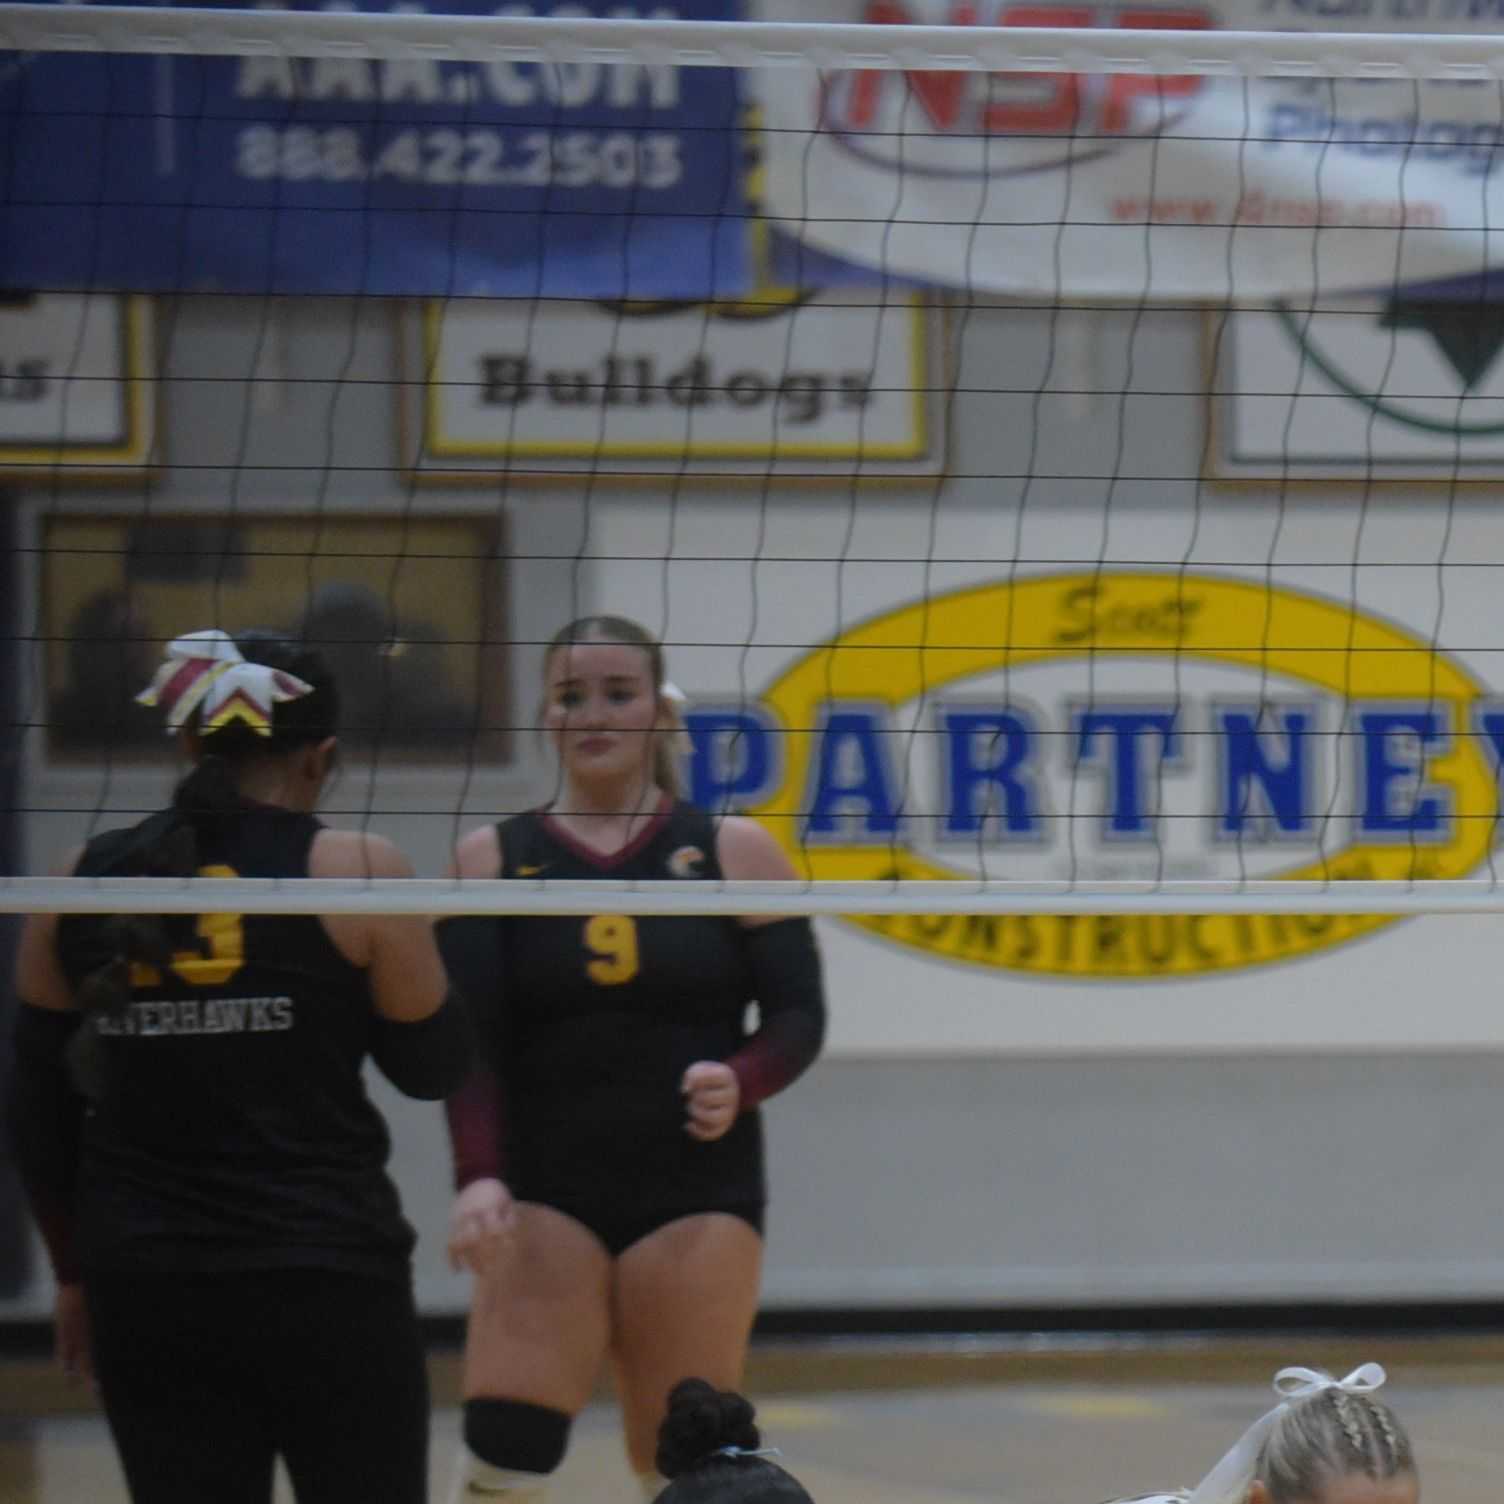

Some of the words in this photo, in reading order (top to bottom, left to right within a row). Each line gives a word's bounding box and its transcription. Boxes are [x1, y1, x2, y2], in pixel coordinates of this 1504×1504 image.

[237, 125, 684, 189] 888.422.2503
[475, 351, 874, 424] Bulldogs
[586, 914, 641, 985] 9
